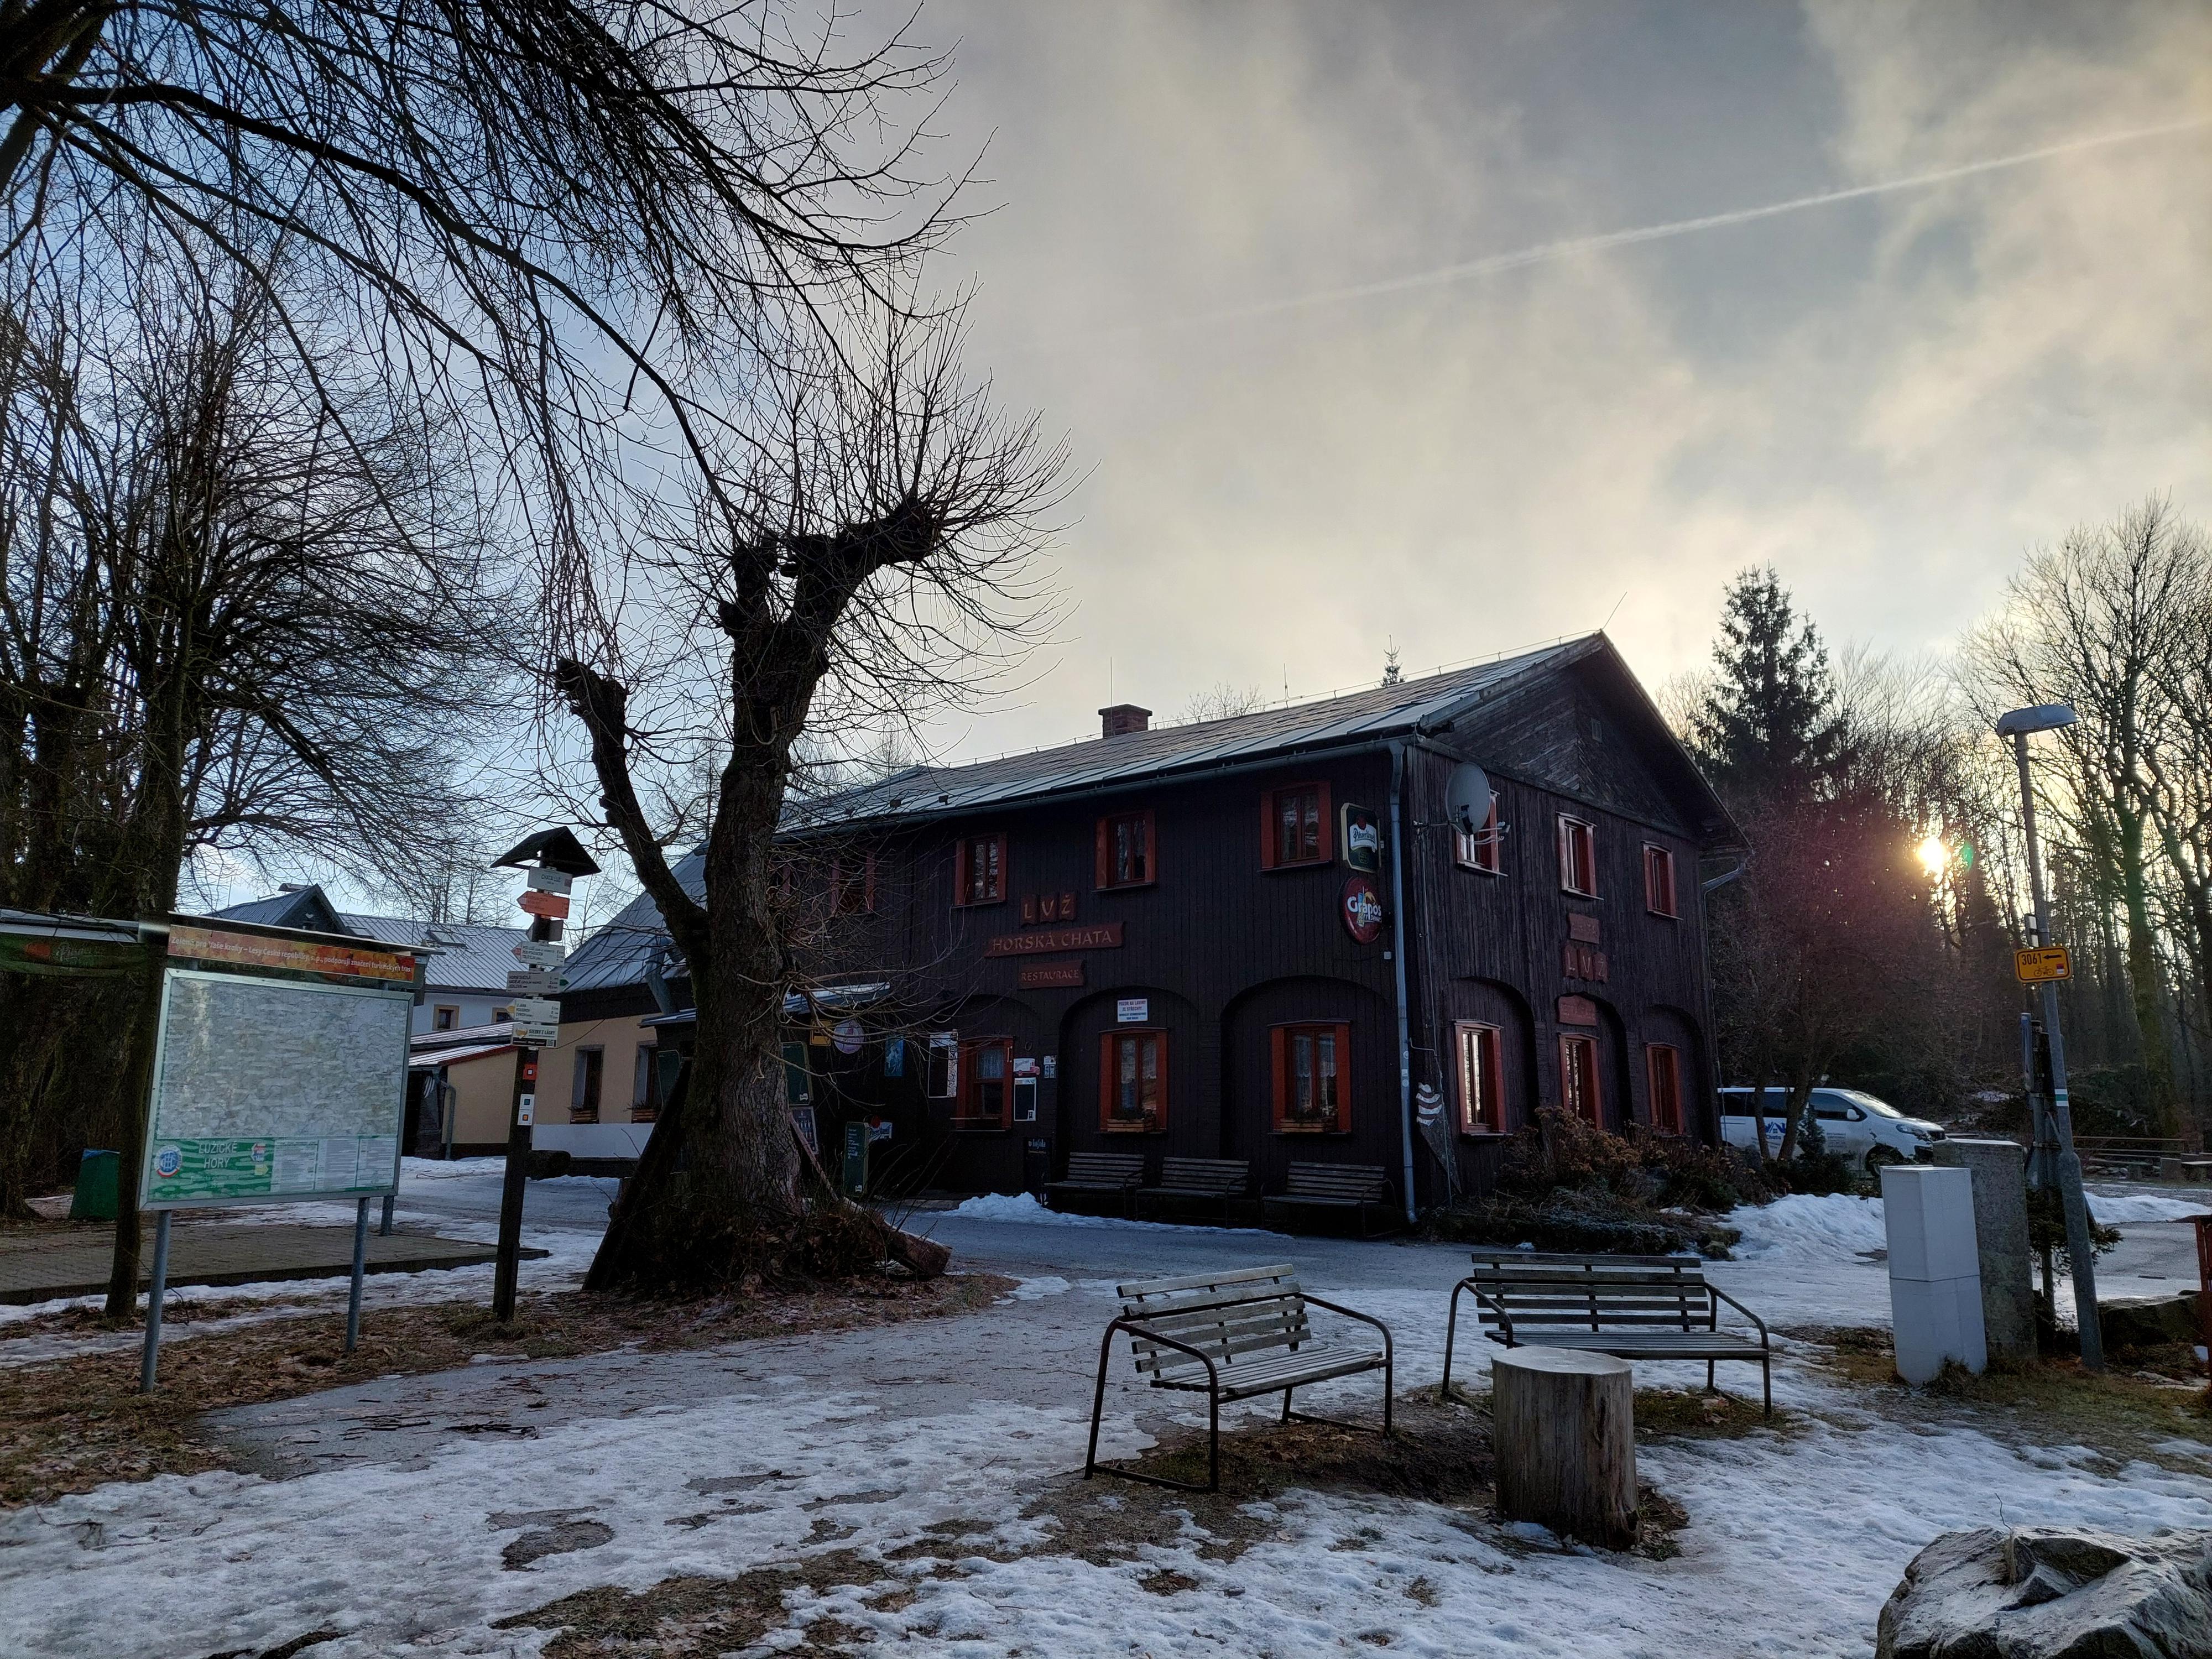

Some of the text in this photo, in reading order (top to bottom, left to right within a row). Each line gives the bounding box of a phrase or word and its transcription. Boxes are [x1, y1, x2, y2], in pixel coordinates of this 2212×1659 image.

[1347, 895, 1382, 920] Grapos
[993, 930, 1113, 952] HORSKÁ CHATA
[249, 946, 263, 956] Lesy
[324, 957, 350, 966] podporují
[351, 958, 371, 968] značení
[371, 961, 400, 972] turistických
[2021, 953, 2042, 965] 3061
[199, 1140, 238, 1154] LUŽICKÉ
[204, 1157, 231, 1168] HORY
